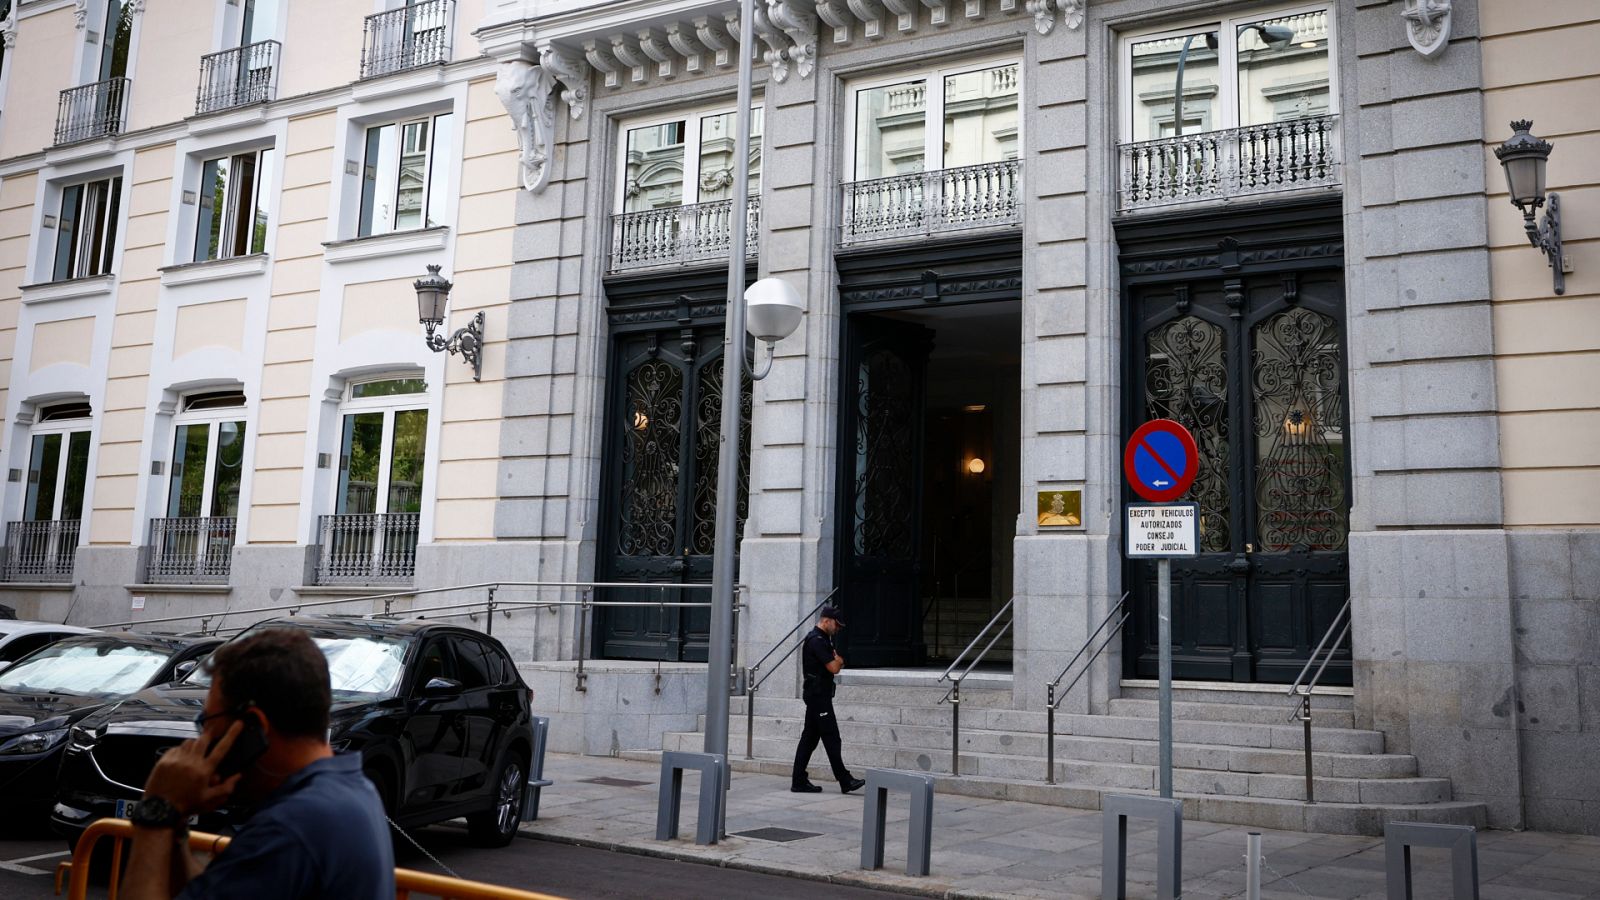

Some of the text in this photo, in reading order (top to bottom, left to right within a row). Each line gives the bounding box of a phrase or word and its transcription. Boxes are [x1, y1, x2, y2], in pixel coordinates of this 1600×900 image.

[1130, 509, 1193, 518] EXCEPTO VEHICULOS
[1136, 543, 1187, 551] PODER JUDICIAL
